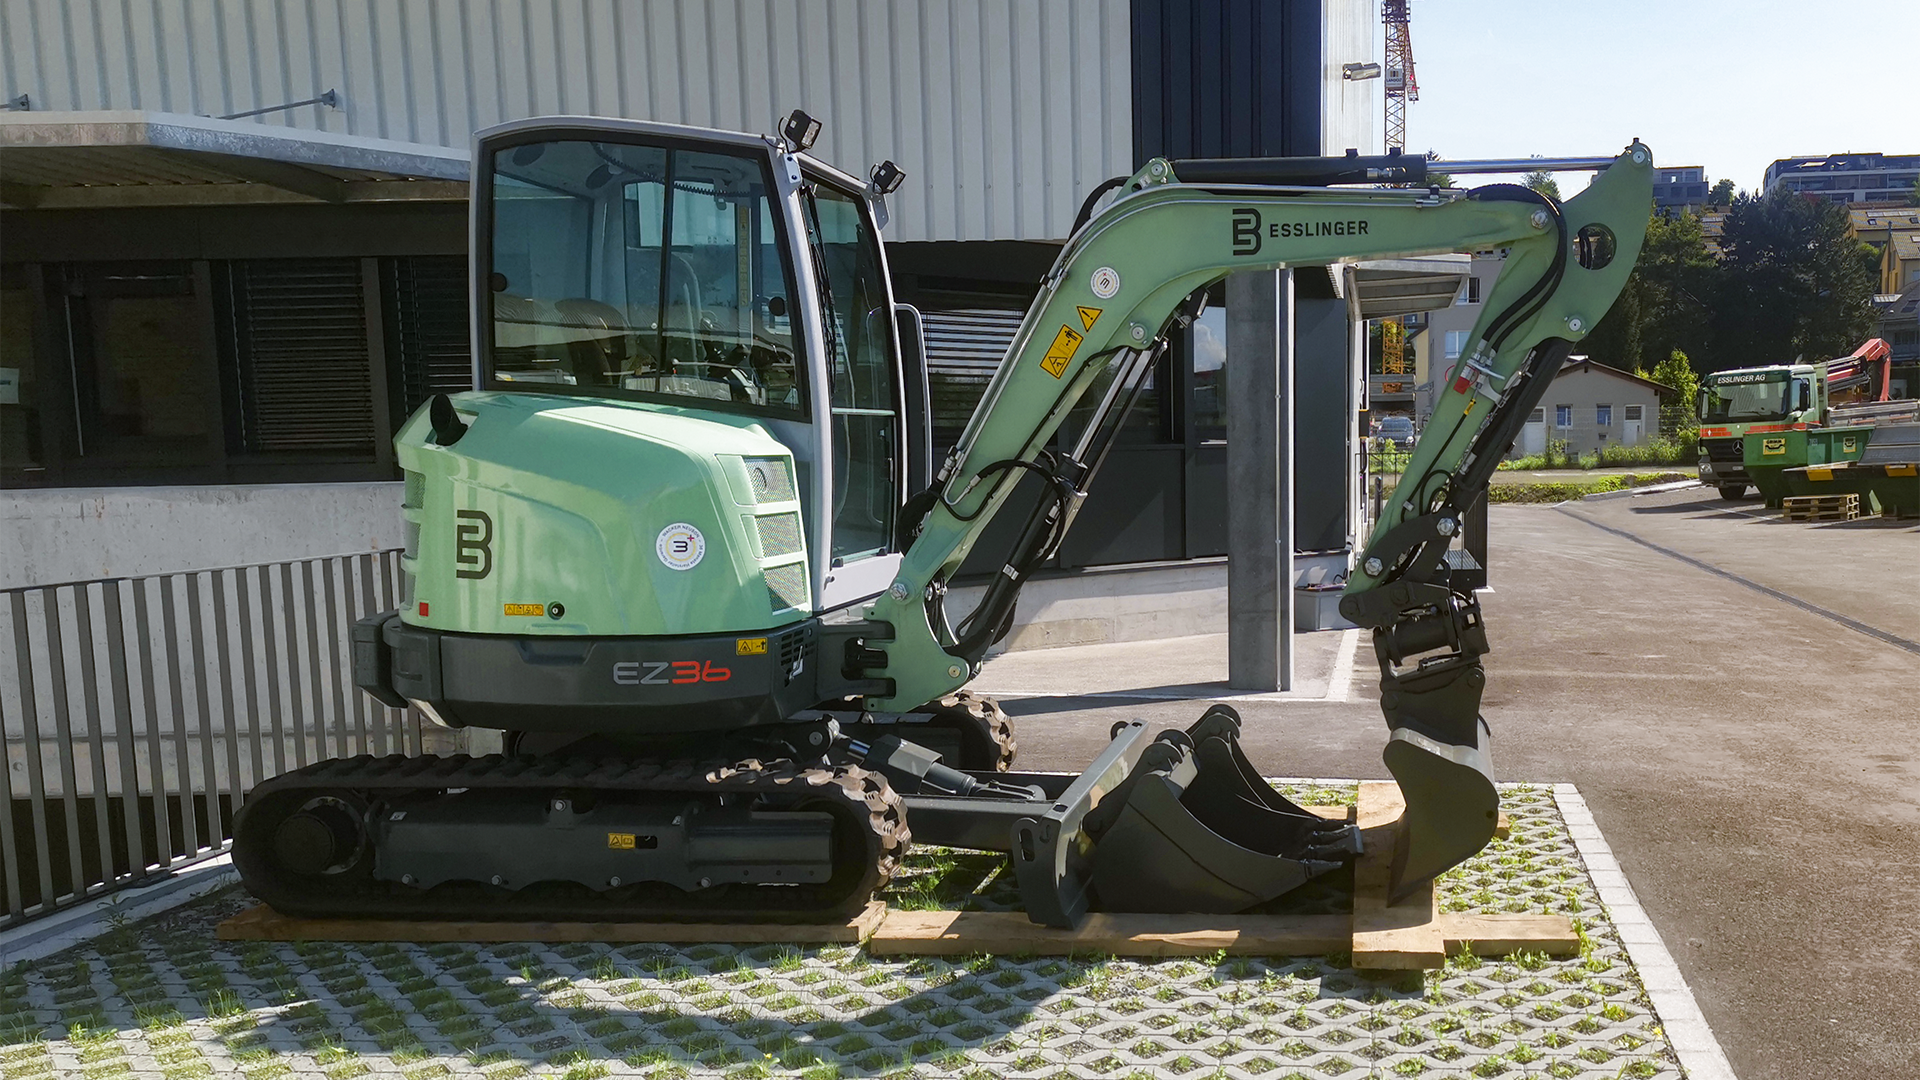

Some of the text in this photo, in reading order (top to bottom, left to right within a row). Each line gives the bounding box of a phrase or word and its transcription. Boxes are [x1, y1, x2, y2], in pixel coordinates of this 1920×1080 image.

[1269, 220, 1369, 238] ESSLINGER
[1717, 374, 1766, 384] ESSLINGER AG
[662, 524, 700, 538] WACKER NEUSON
[613, 660, 731, 684] EZ36
